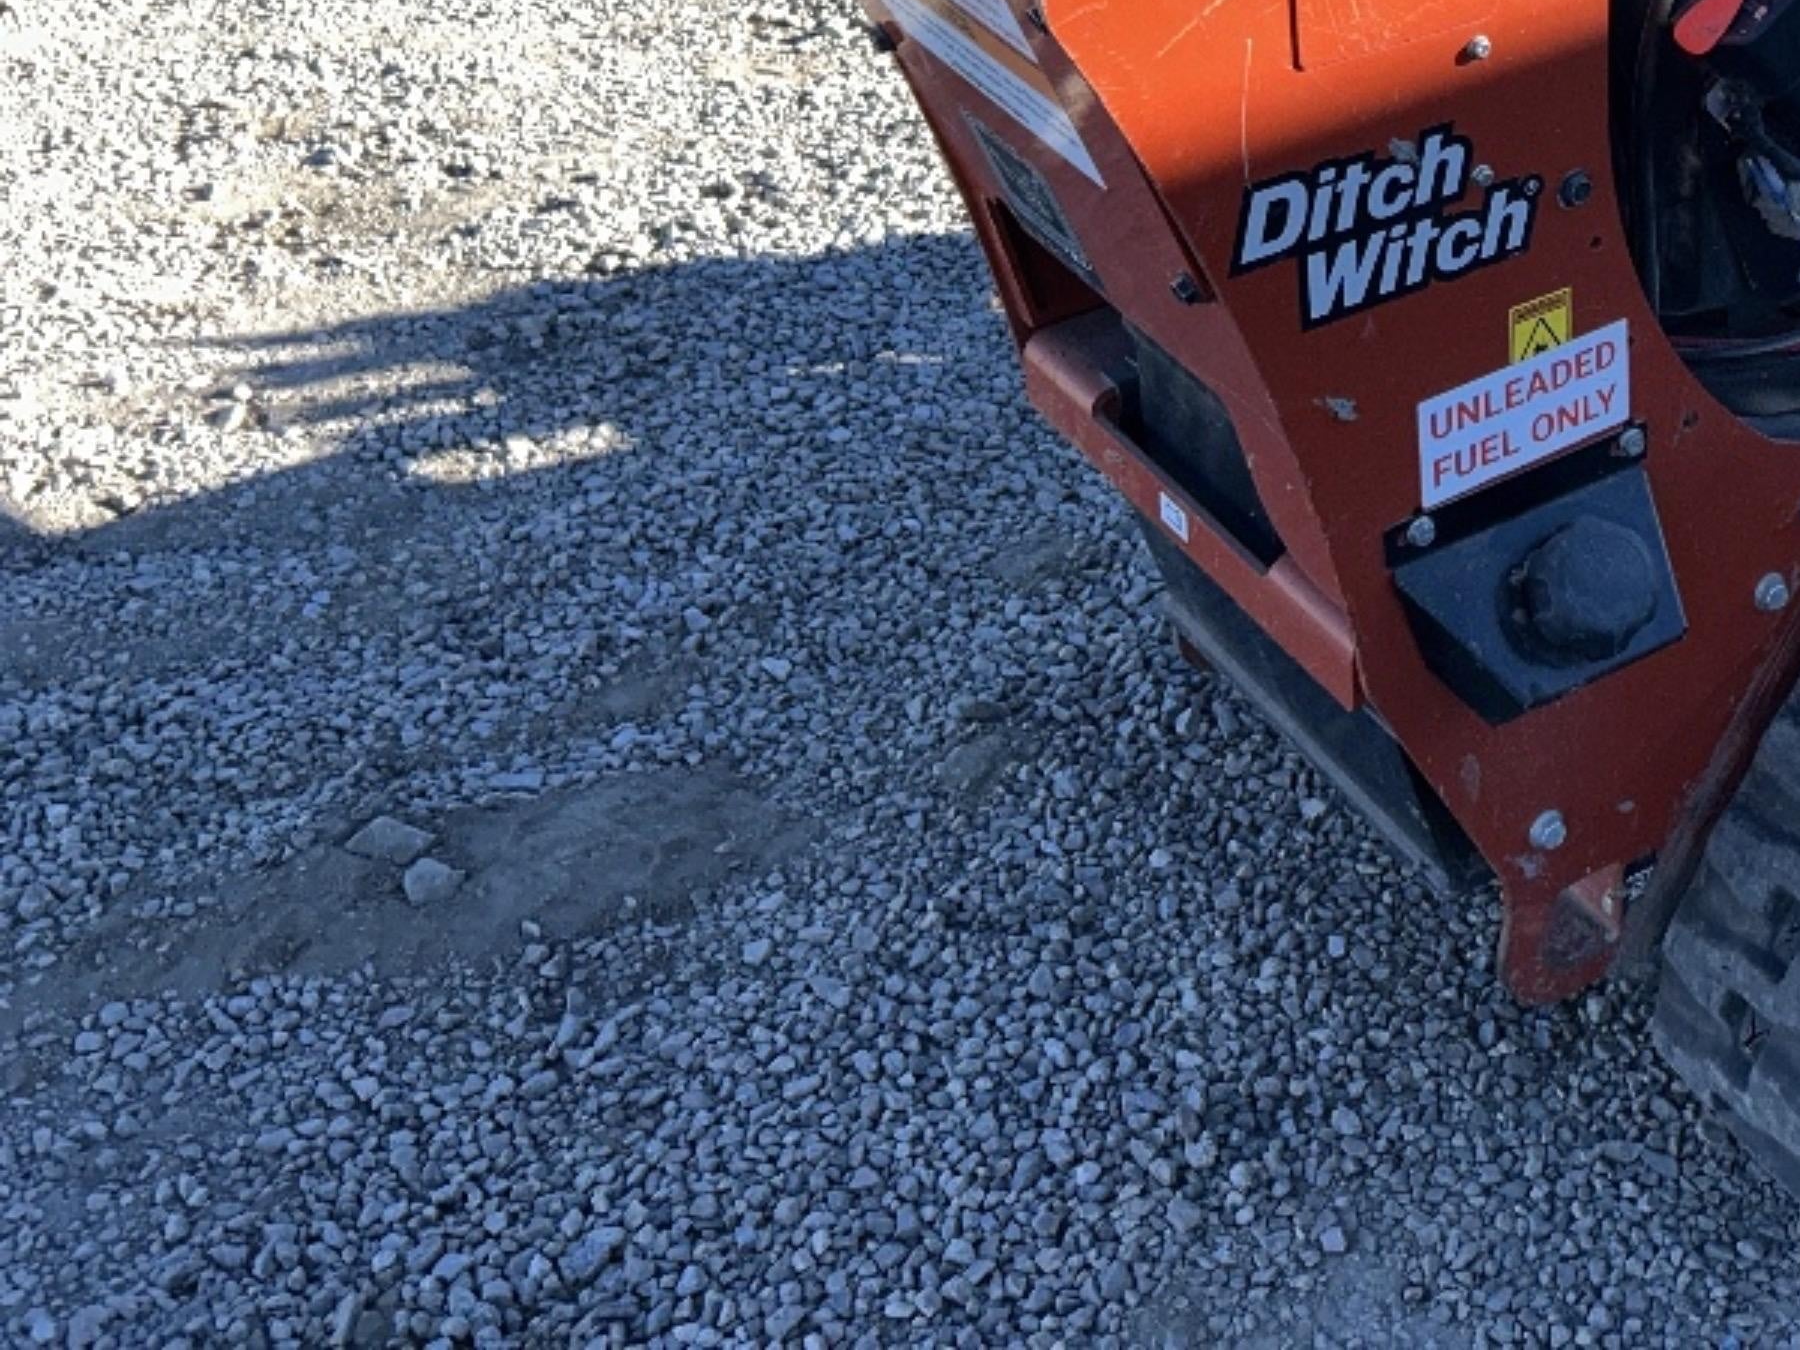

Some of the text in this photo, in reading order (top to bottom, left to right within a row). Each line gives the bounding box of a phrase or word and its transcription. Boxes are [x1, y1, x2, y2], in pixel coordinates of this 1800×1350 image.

[1240, 132, 1467, 266] Ditch
[1306, 188, 1531, 322] Witch
[1429, 340, 1617, 440] UNLEADED
[1432, 383, 1617, 489] FUEL ONLY
